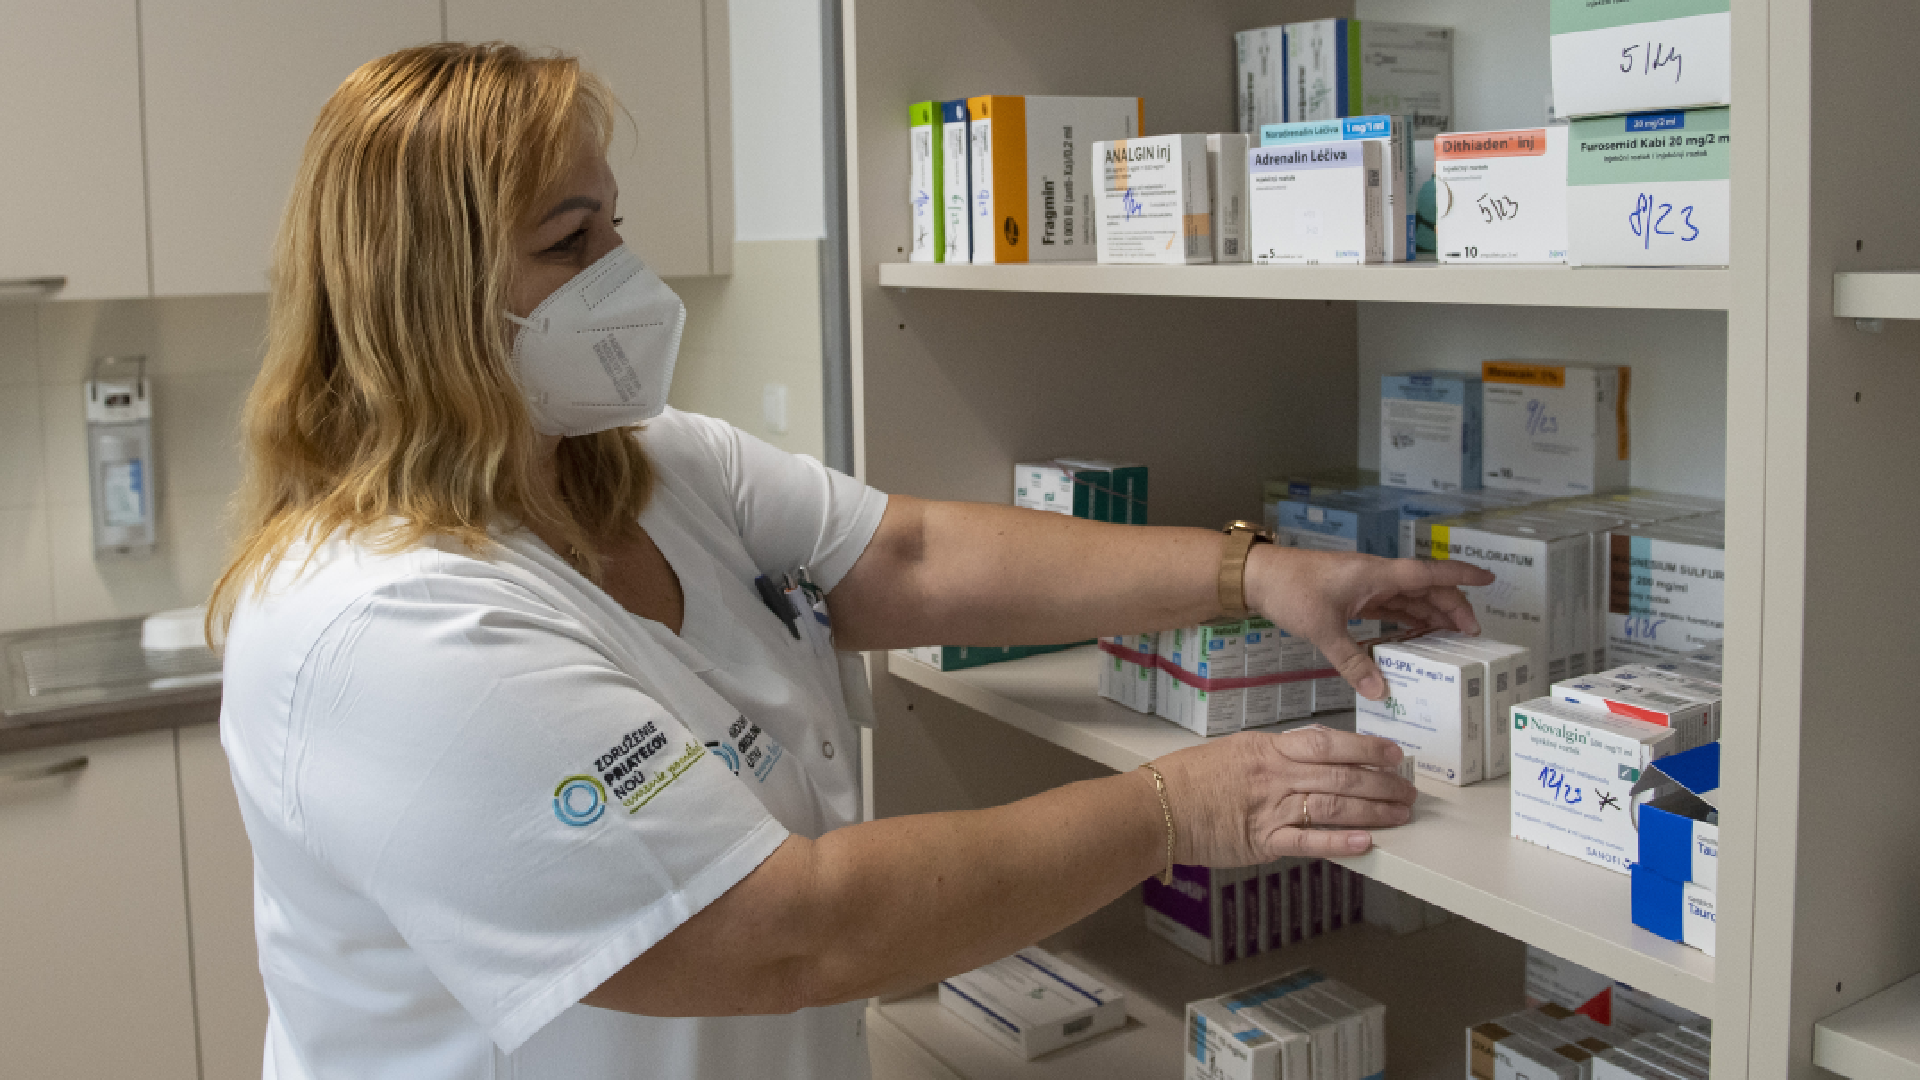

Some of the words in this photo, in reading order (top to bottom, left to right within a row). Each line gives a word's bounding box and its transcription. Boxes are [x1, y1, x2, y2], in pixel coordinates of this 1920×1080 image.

[1265, 127, 1314, 141] Noradrenalin
[1580, 138, 1637, 152] Furosemid
[1640, 136, 1666, 149] Kabi
[1668, 135, 1683, 147] 20
[1685, 134, 1716, 149] mg/2
[1442, 137, 1508, 153] Dithiaden
[1517, 135, 1535, 151] inj
[1105, 146, 1155, 164] ANALGIN
[1157, 144, 1171, 164] inj
[1255, 151, 1308, 166] Adrenalin
[1311, 148, 1348, 163] Léčiva
[1041, 181, 1057, 246] Fragmin
[1628, 192, 1699, 250] 8/23
[1269, 248, 1276, 259] 5
[1463, 246, 1478, 259] 10
[1465, 545, 1533, 567] CHLORATUM
[1379, 655, 1412, 673] NO-SPA
[1530, 715, 1587, 746] Novalgin
[1538, 766, 1582, 804] 12/23
